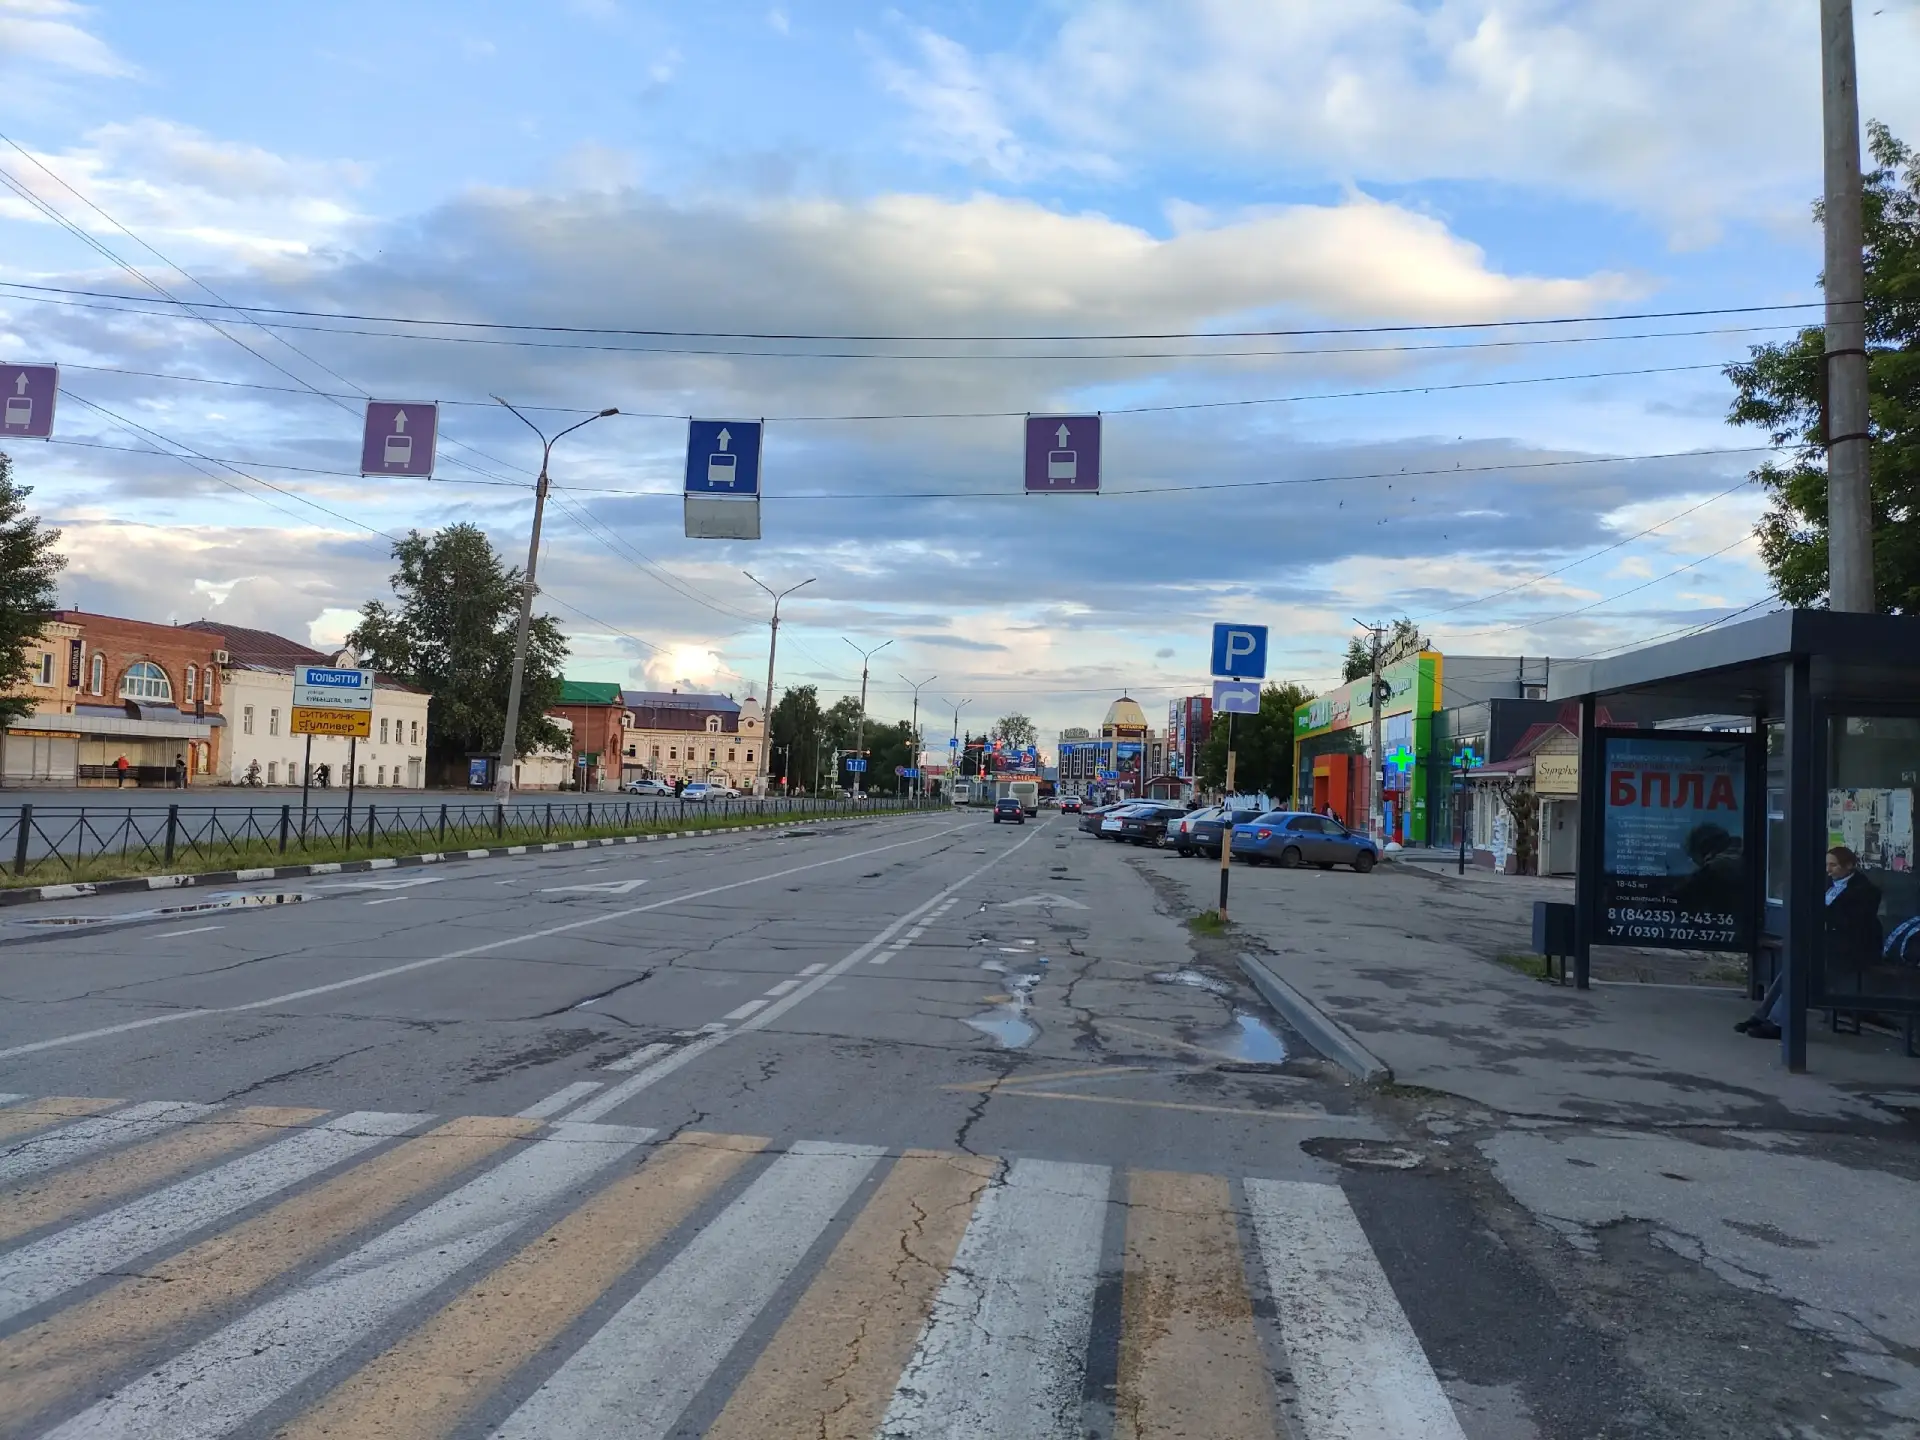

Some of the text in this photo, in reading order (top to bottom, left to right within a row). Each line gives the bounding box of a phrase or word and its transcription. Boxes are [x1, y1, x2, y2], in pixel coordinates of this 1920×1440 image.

[1225, 631, 1256, 670] P
[72, 646, 80, 681] БАНКОМАТ
[310, 672, 358, 684] ТОЛЬЯТТИ
[306, 719, 355, 732] Гулливер
[1610, 771, 1738, 811] БПЛА
[1608, 907, 1734, 926] 8 (84235) 2-43-36
[1608, 925, 1736, 943] +7 (939) 707-37-77
